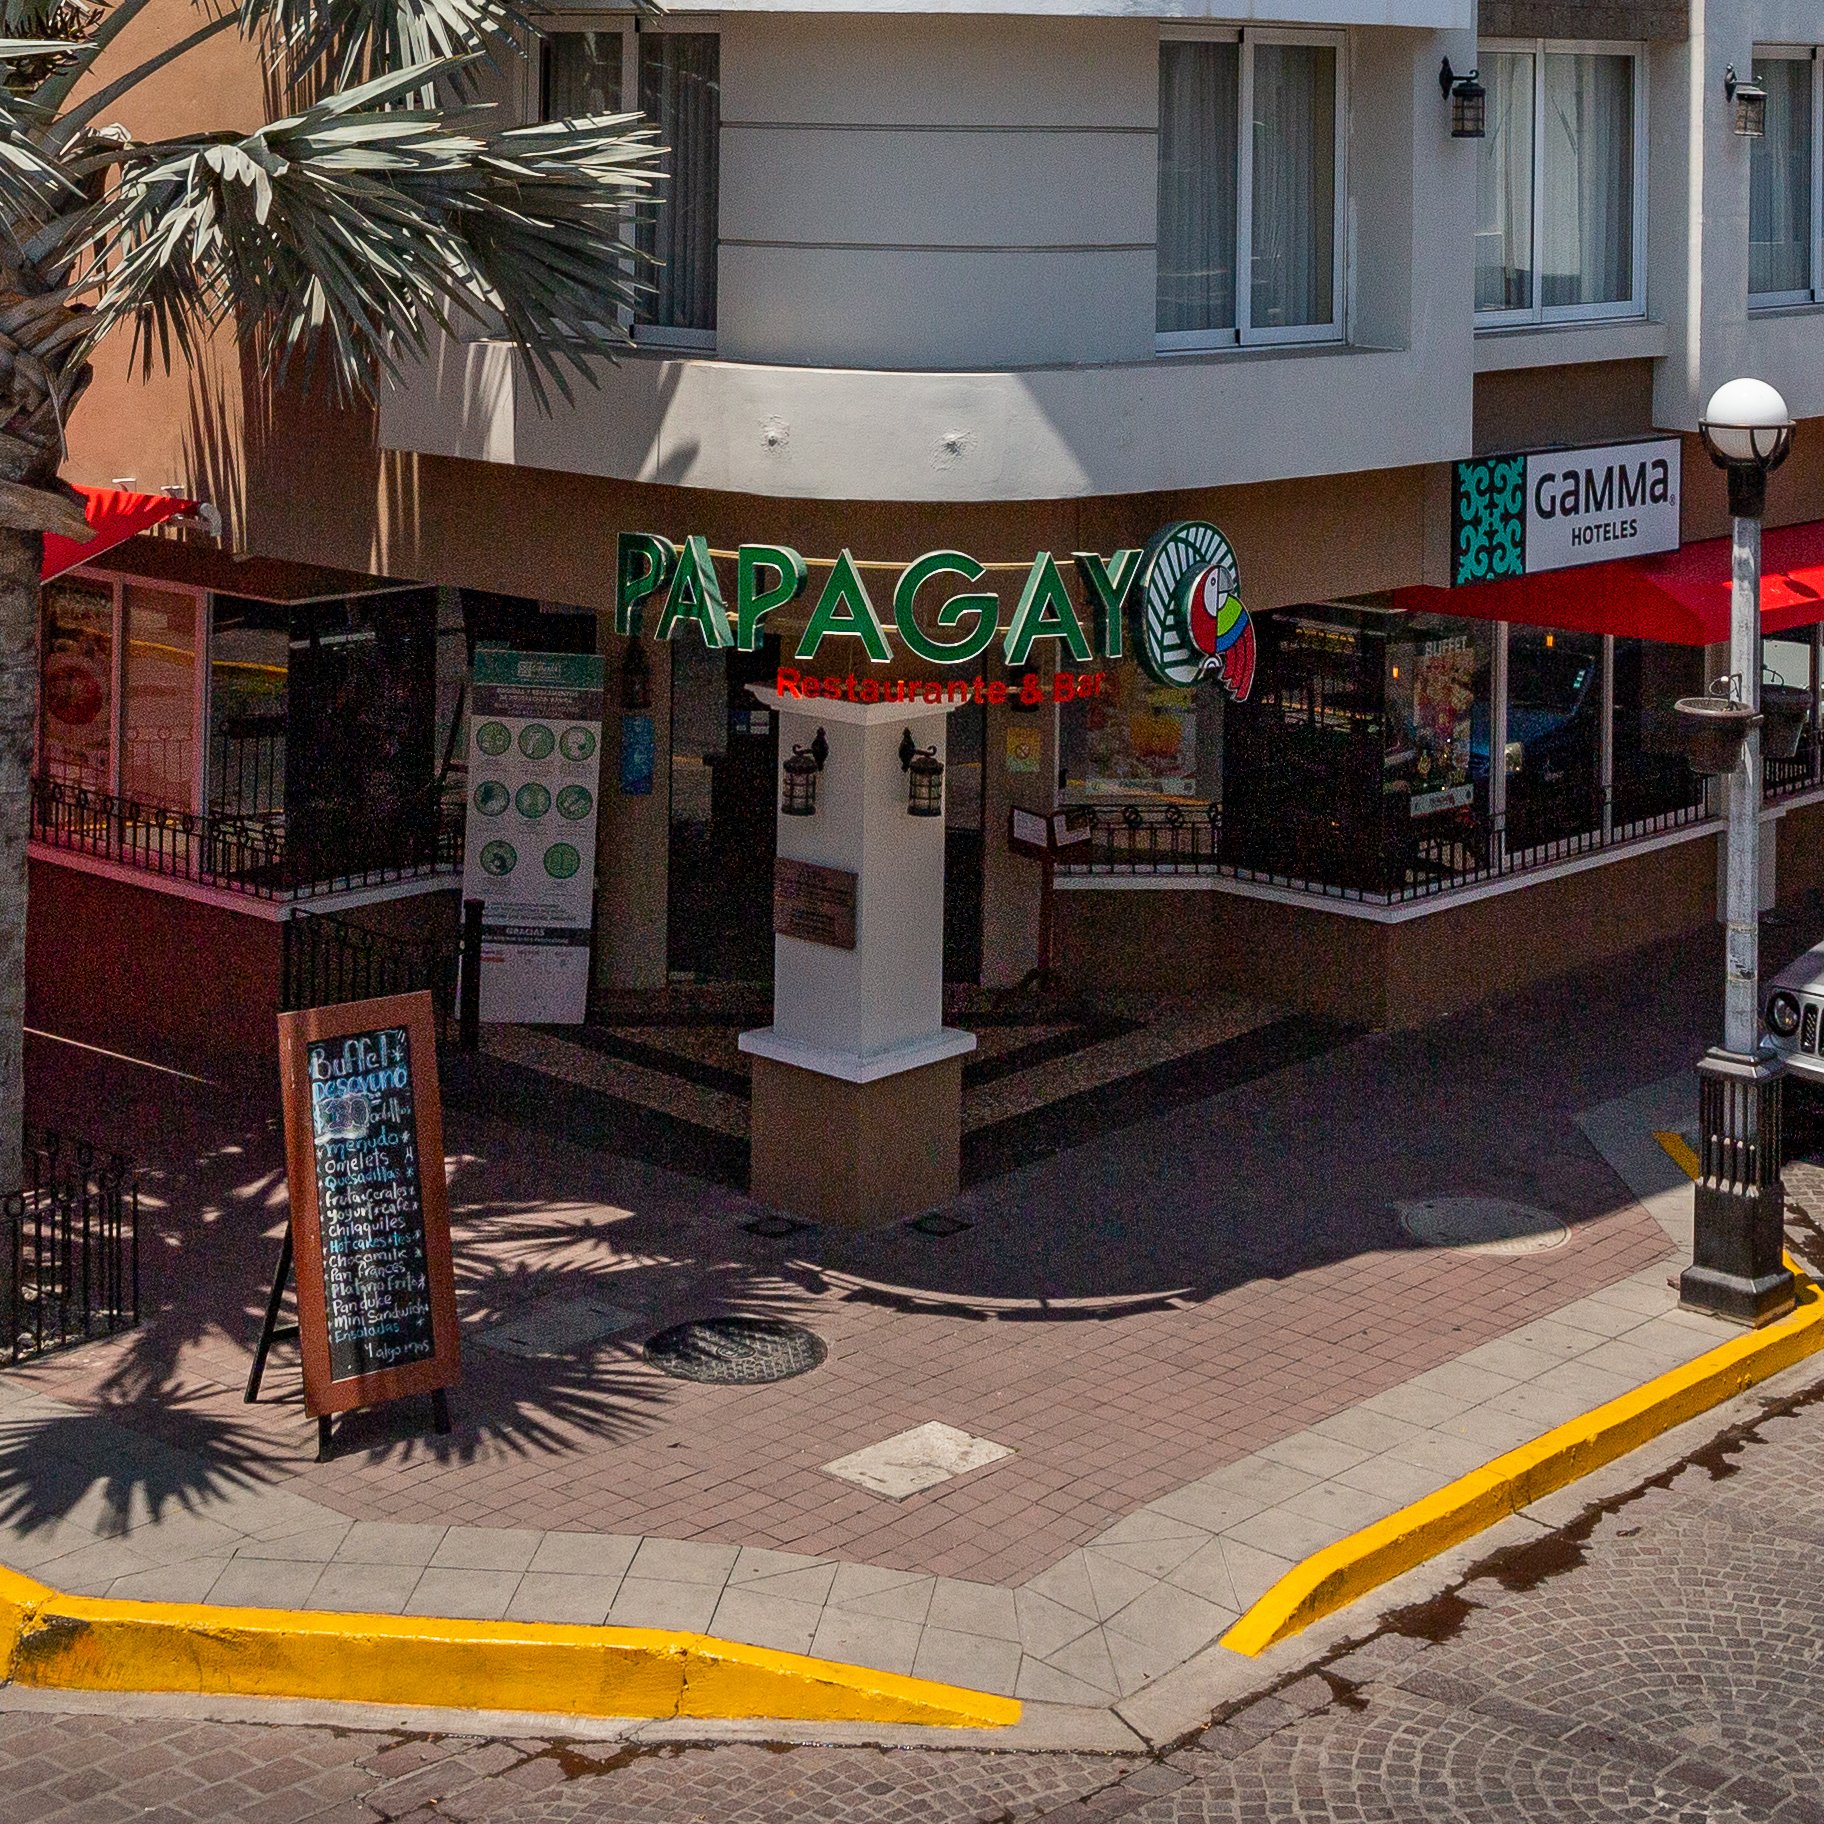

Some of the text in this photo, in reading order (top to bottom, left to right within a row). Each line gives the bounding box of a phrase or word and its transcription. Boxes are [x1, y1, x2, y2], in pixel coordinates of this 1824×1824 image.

[1571, 518, 1638, 547] HOTELES
[776, 666, 1107, 705] Restaurante & Bar
